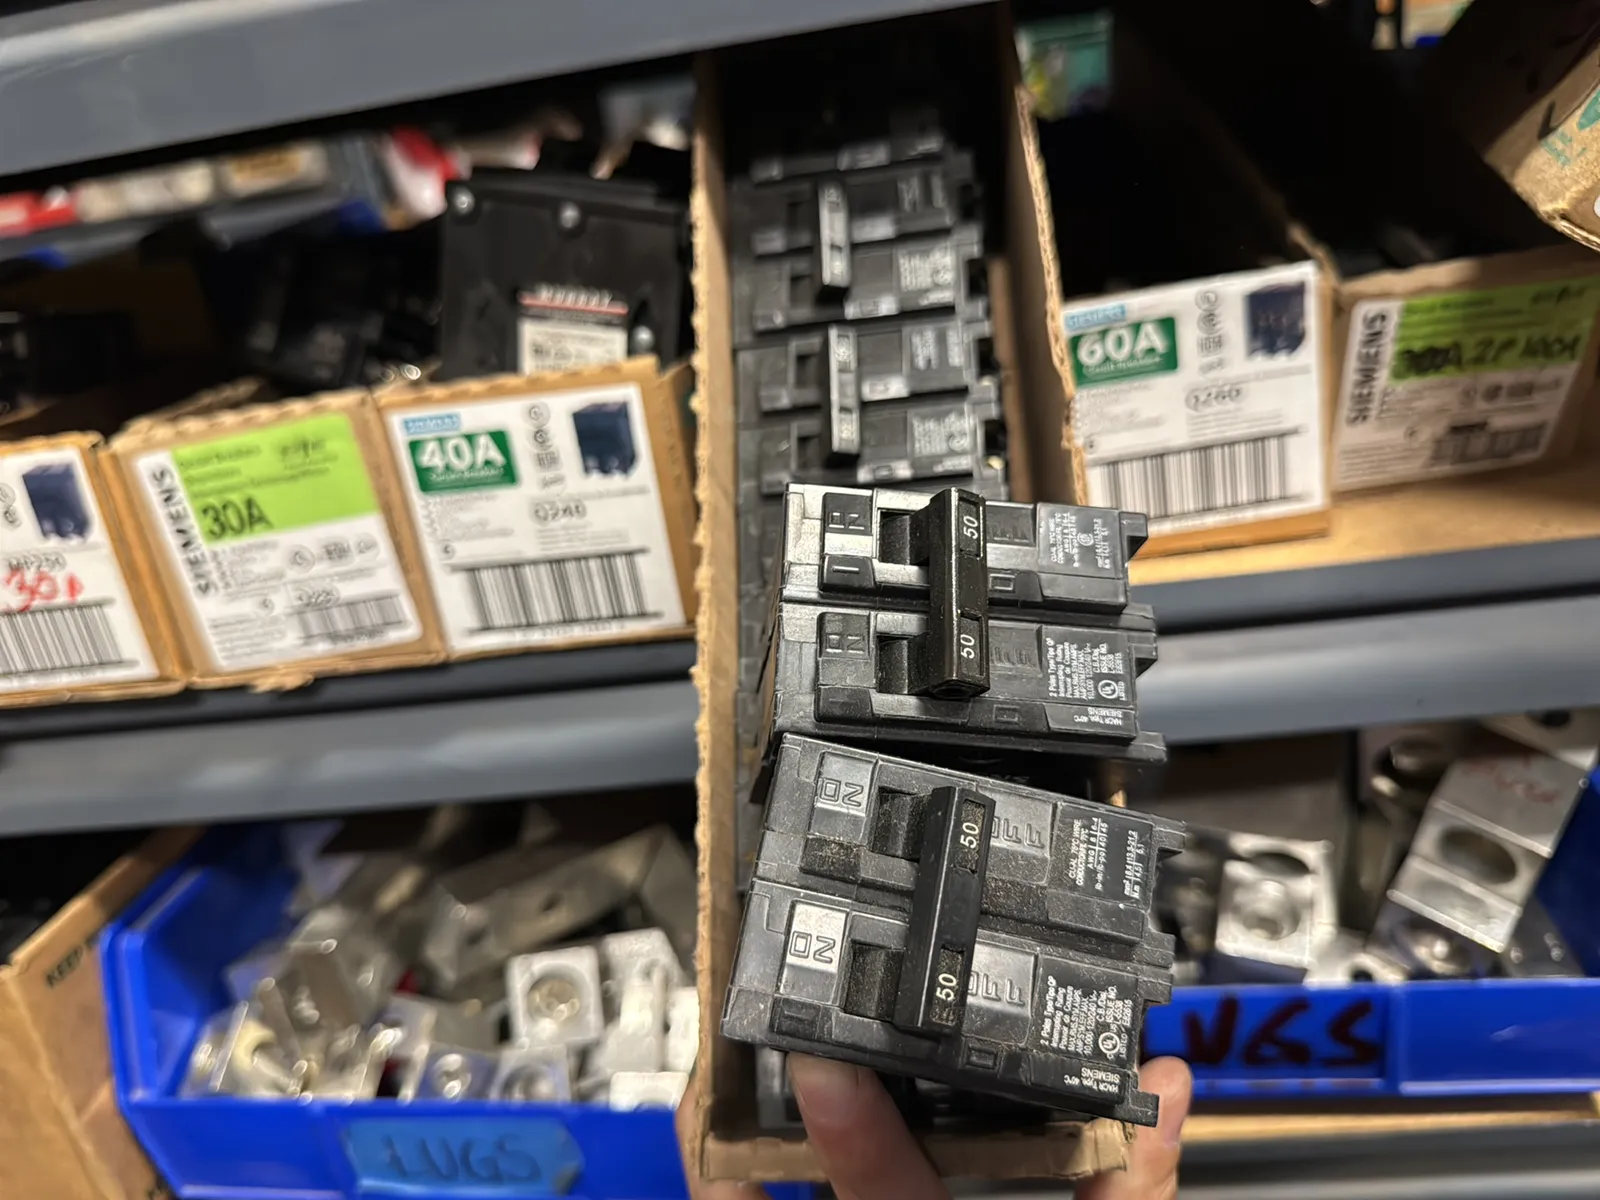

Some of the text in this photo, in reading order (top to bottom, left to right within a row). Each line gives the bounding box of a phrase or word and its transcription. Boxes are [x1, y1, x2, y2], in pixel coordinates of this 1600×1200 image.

[1077, 322, 1168, 363] 60A
[1346, 311, 1387, 426] SIEMENS
[419, 434, 505, 470] 40A
[151, 466, 217, 597] SIEMENS
[202, 497, 274, 540] 30A
[963, 515, 978, 540] 50
[826, 634, 865, 654] ON
[960, 633, 975, 660] 50
[1048, 673, 1057, 691] Poles
[1117, 680, 1126, 701] LISTED
[1087, 706, 1122, 718] SIEMENS
[1104, 717, 1122, 726] HACR
[819, 777, 865, 808] ON
[959, 821, 980, 849] 50
[1073, 818, 1082, 839] WIRE
[1091, 816, 1099, 830] 6-4
[1100, 822, 1109, 834] 45
[1099, 836, 1108, 850] 40
[1087, 849, 1096, 870] AWG
[788, 930, 836, 964] ON
[935, 972, 958, 1002] 50
[1051, 987, 1067, 1048] Interrupting Rating
[1059, 985, 1074, 1050] Pouvoir de Coupure
[1086, 1003, 1098, 1030] 120/240
[1105, 985, 1118, 1024] ISSUE NO.
[1041, 1018, 1052, 1038] Poles
[1083, 1030, 1095, 1056] 10,000
[1118, 1033, 1129, 1060] LISTED
[1081, 1067, 1121, 1084] SIEMENS
[1099, 1081, 1119, 1093] HACR
[380, 1133, 542, 1183] LUGS
